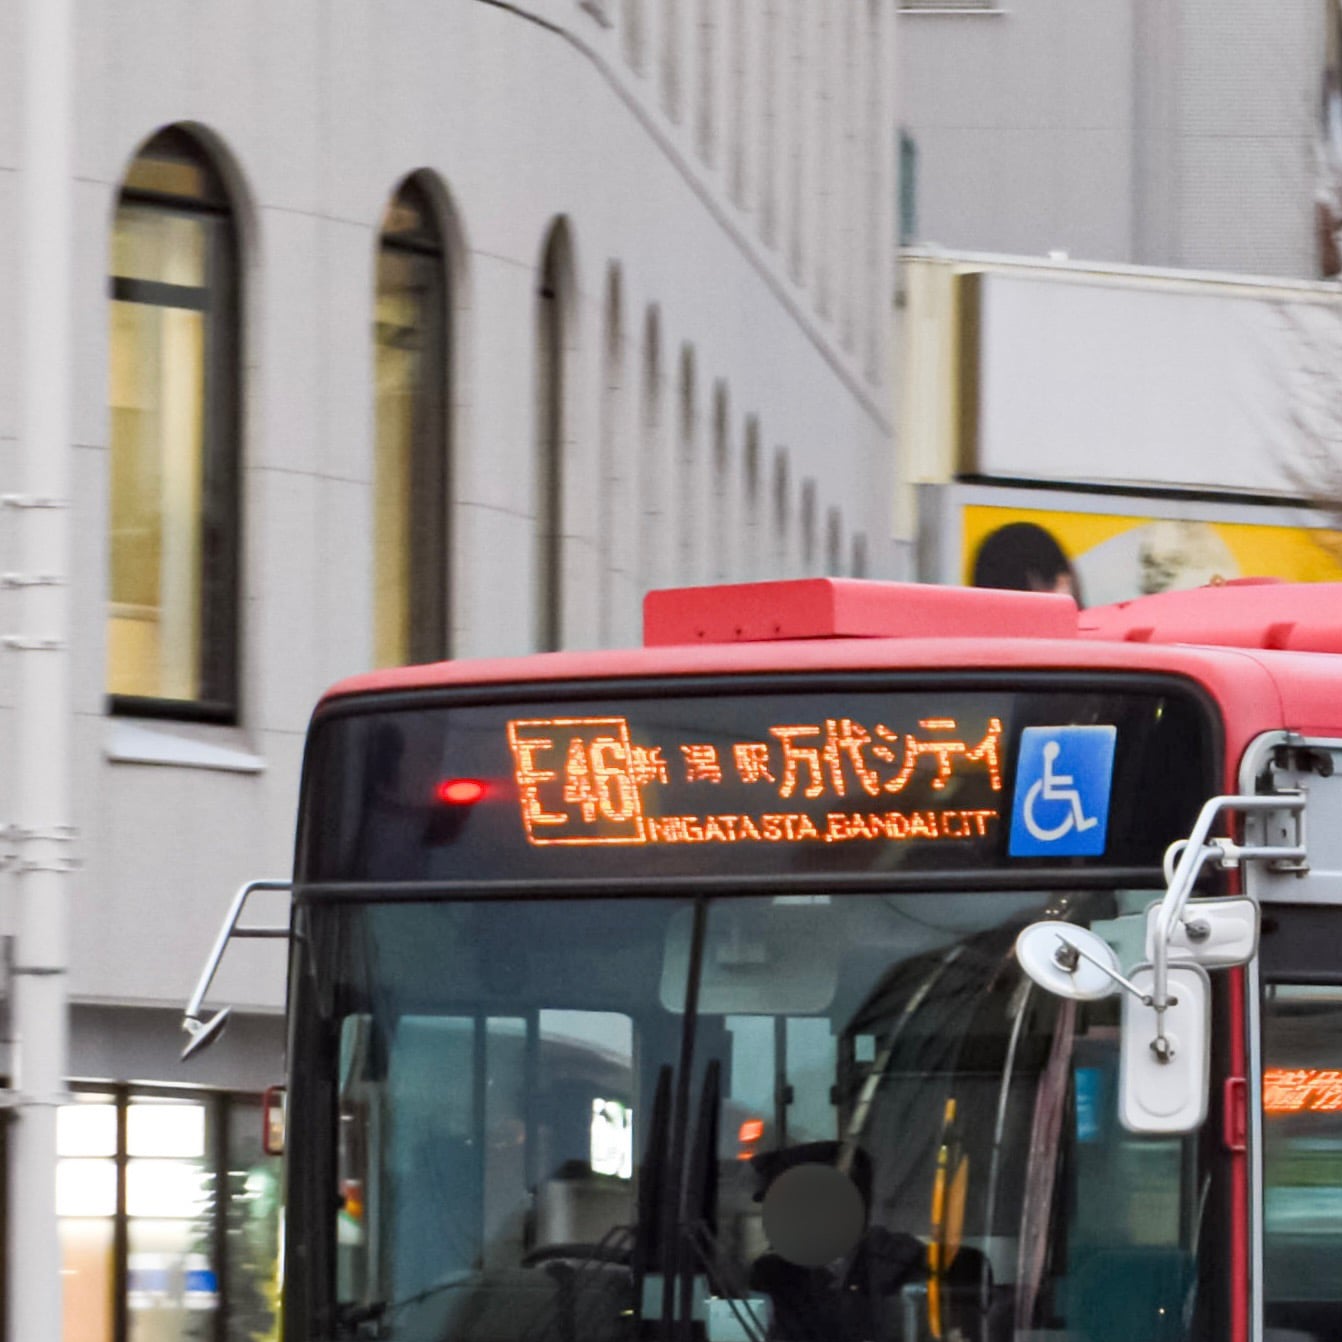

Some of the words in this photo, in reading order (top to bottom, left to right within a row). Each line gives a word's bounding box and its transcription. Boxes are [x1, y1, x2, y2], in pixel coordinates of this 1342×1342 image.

[513, 737, 635, 822] E46
[633, 744, 776, 785] 新潟駅
